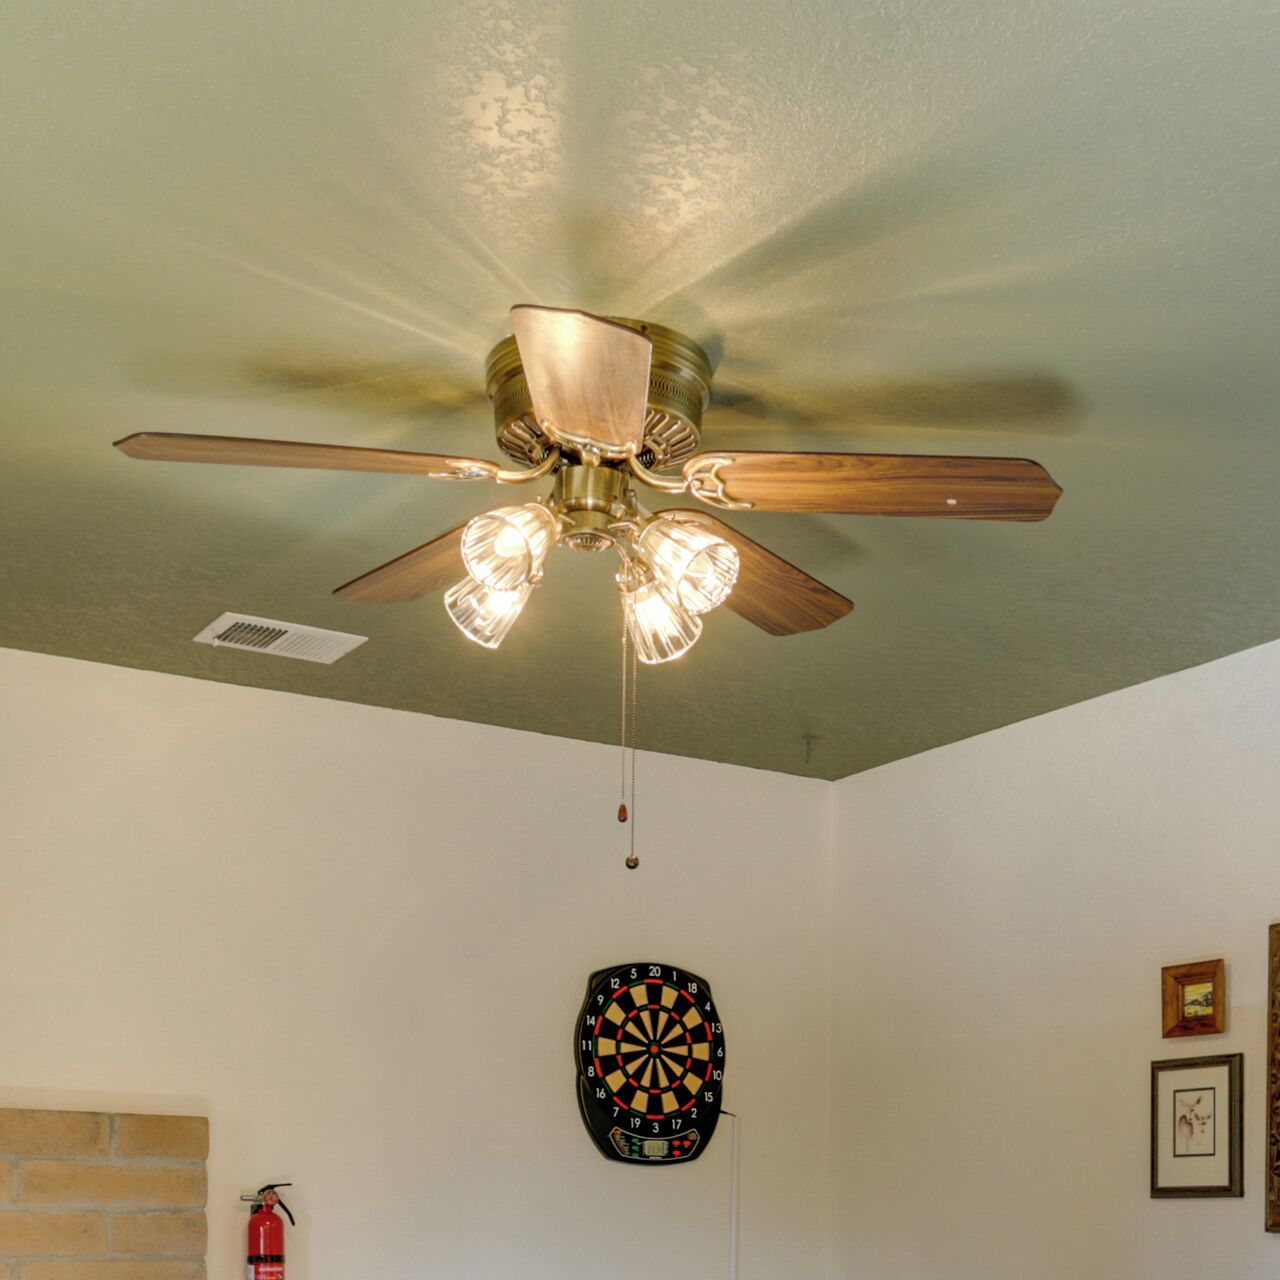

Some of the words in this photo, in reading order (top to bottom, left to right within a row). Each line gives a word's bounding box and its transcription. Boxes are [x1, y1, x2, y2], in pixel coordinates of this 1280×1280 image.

[630, 968, 637, 979] 5
[648, 966, 661, 977] 20
[672, 971, 677, 982] 1
[610, 978, 620, 989] 12
[687, 983, 698, 994] 18
[597, 995, 604, 1006] 9
[704, 1001, 711, 1012] 4
[586, 1015, 596, 1026] 14
[711, 1022, 722, 1033] 13
[582, 1040, 592, 1051] 11
[717, 1047, 723, 1057] 6
[587, 1066, 595, 1077] 8
[713, 1070, 722, 1081] 10
[596, 1088, 606, 1099] 16
[704, 1091, 714, 1102] 15
[613, 1107, 620, 1118] 7
[691, 1108, 698, 1118] 2
[630, 1118, 641, 1129] 19
[652, 1122, 660, 1133] 3
[671, 1119, 682, 1130] 17
